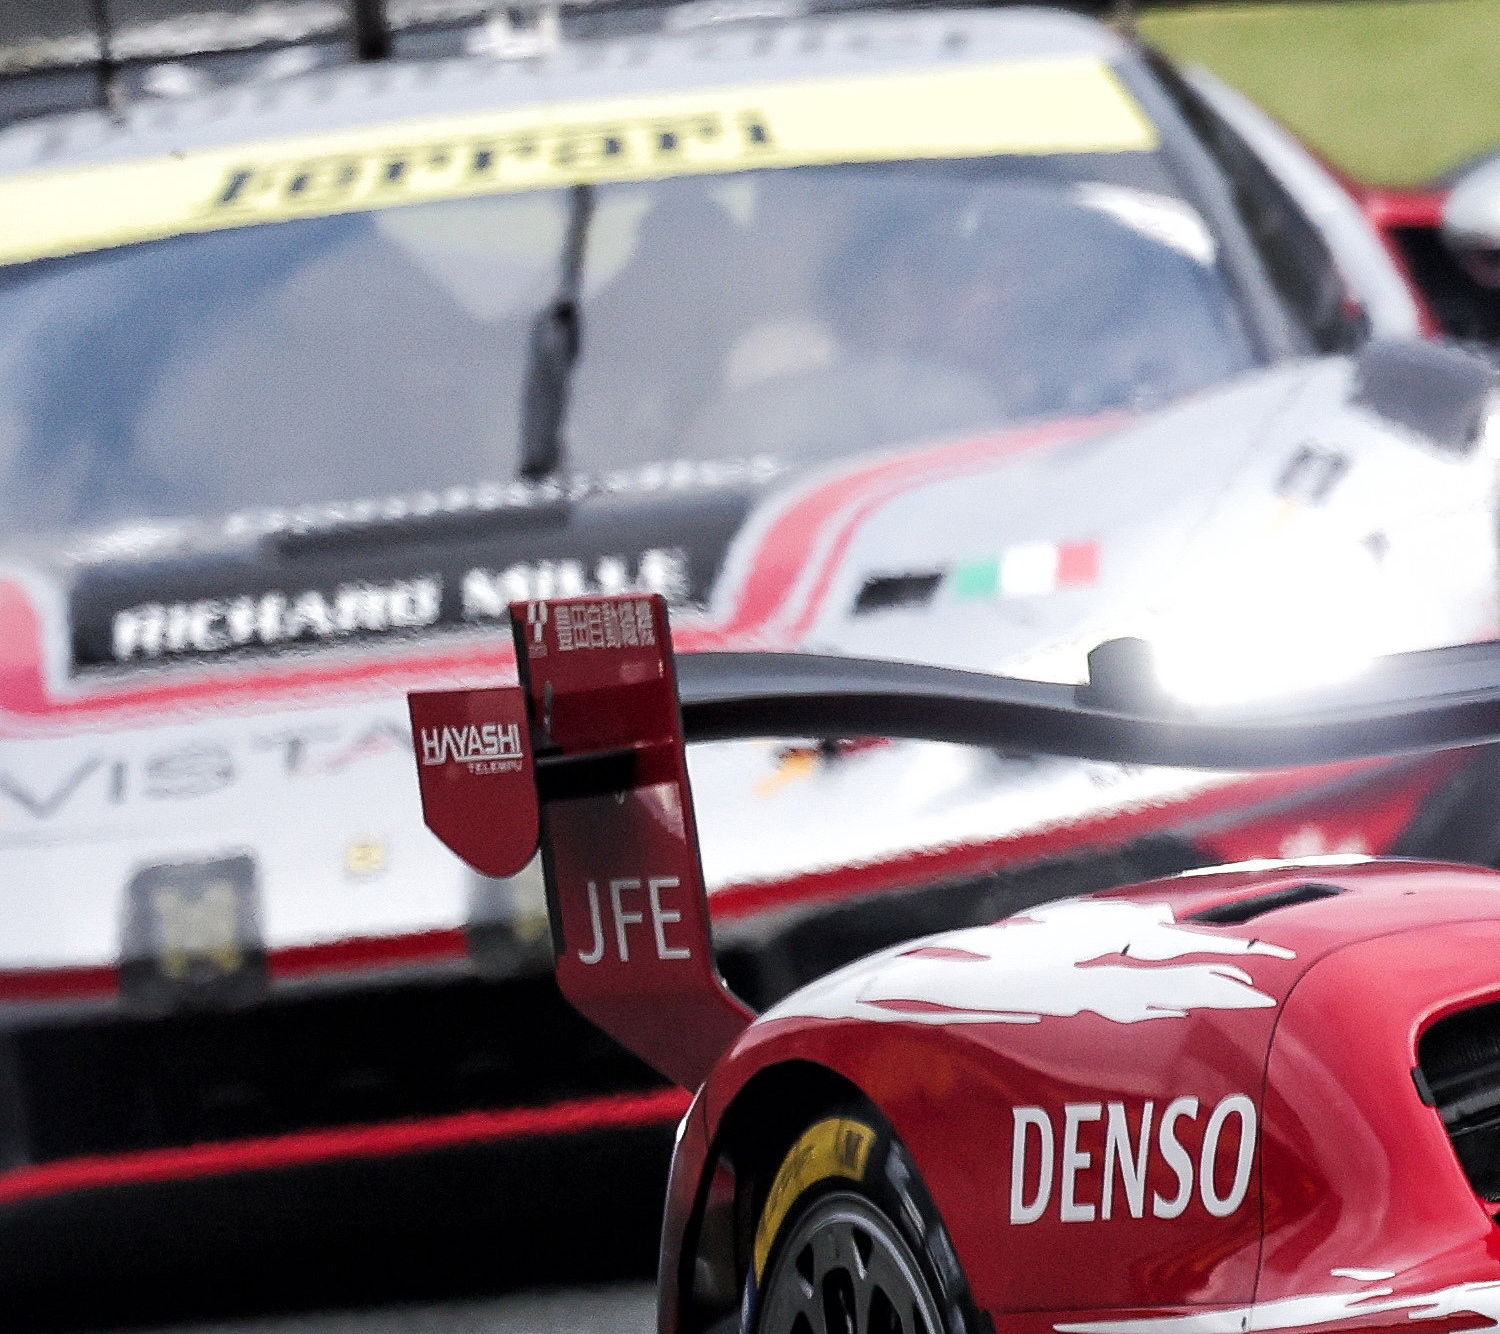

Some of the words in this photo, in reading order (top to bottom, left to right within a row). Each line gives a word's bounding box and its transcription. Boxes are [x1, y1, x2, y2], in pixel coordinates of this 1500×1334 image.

[110, 575, 442, 660] RICHARD
[420, 723, 524, 766] HAYASHI
[578, 877, 691, 965] JFE
[1009, 1092, 1258, 1226] DENSO
